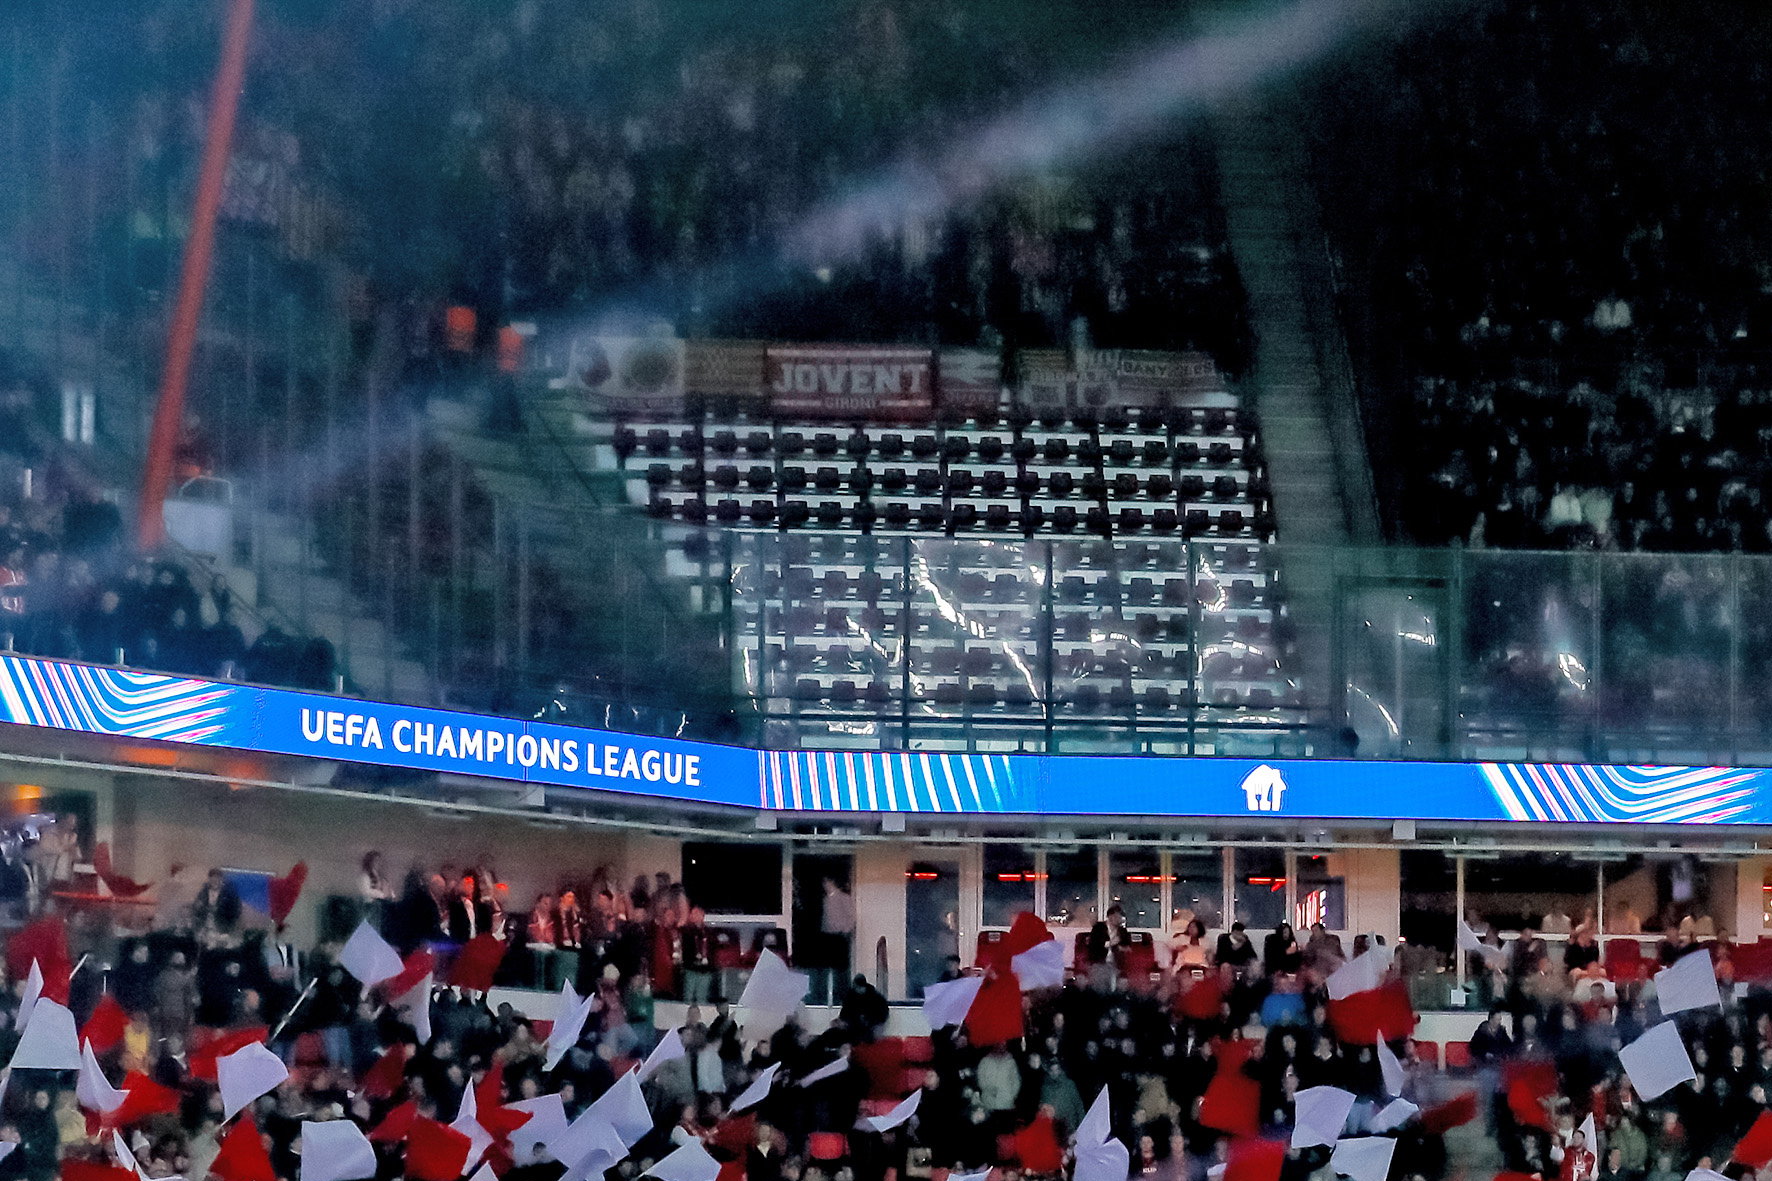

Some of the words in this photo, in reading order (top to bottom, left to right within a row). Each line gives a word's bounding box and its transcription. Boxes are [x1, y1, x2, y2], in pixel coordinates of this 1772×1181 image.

[772, 363, 929, 393] JOVENT
[301, 709, 383, 750] UEFA
[392, 720, 579, 772] CHAMPIONS
[585, 744, 701, 787] LEAGUE
